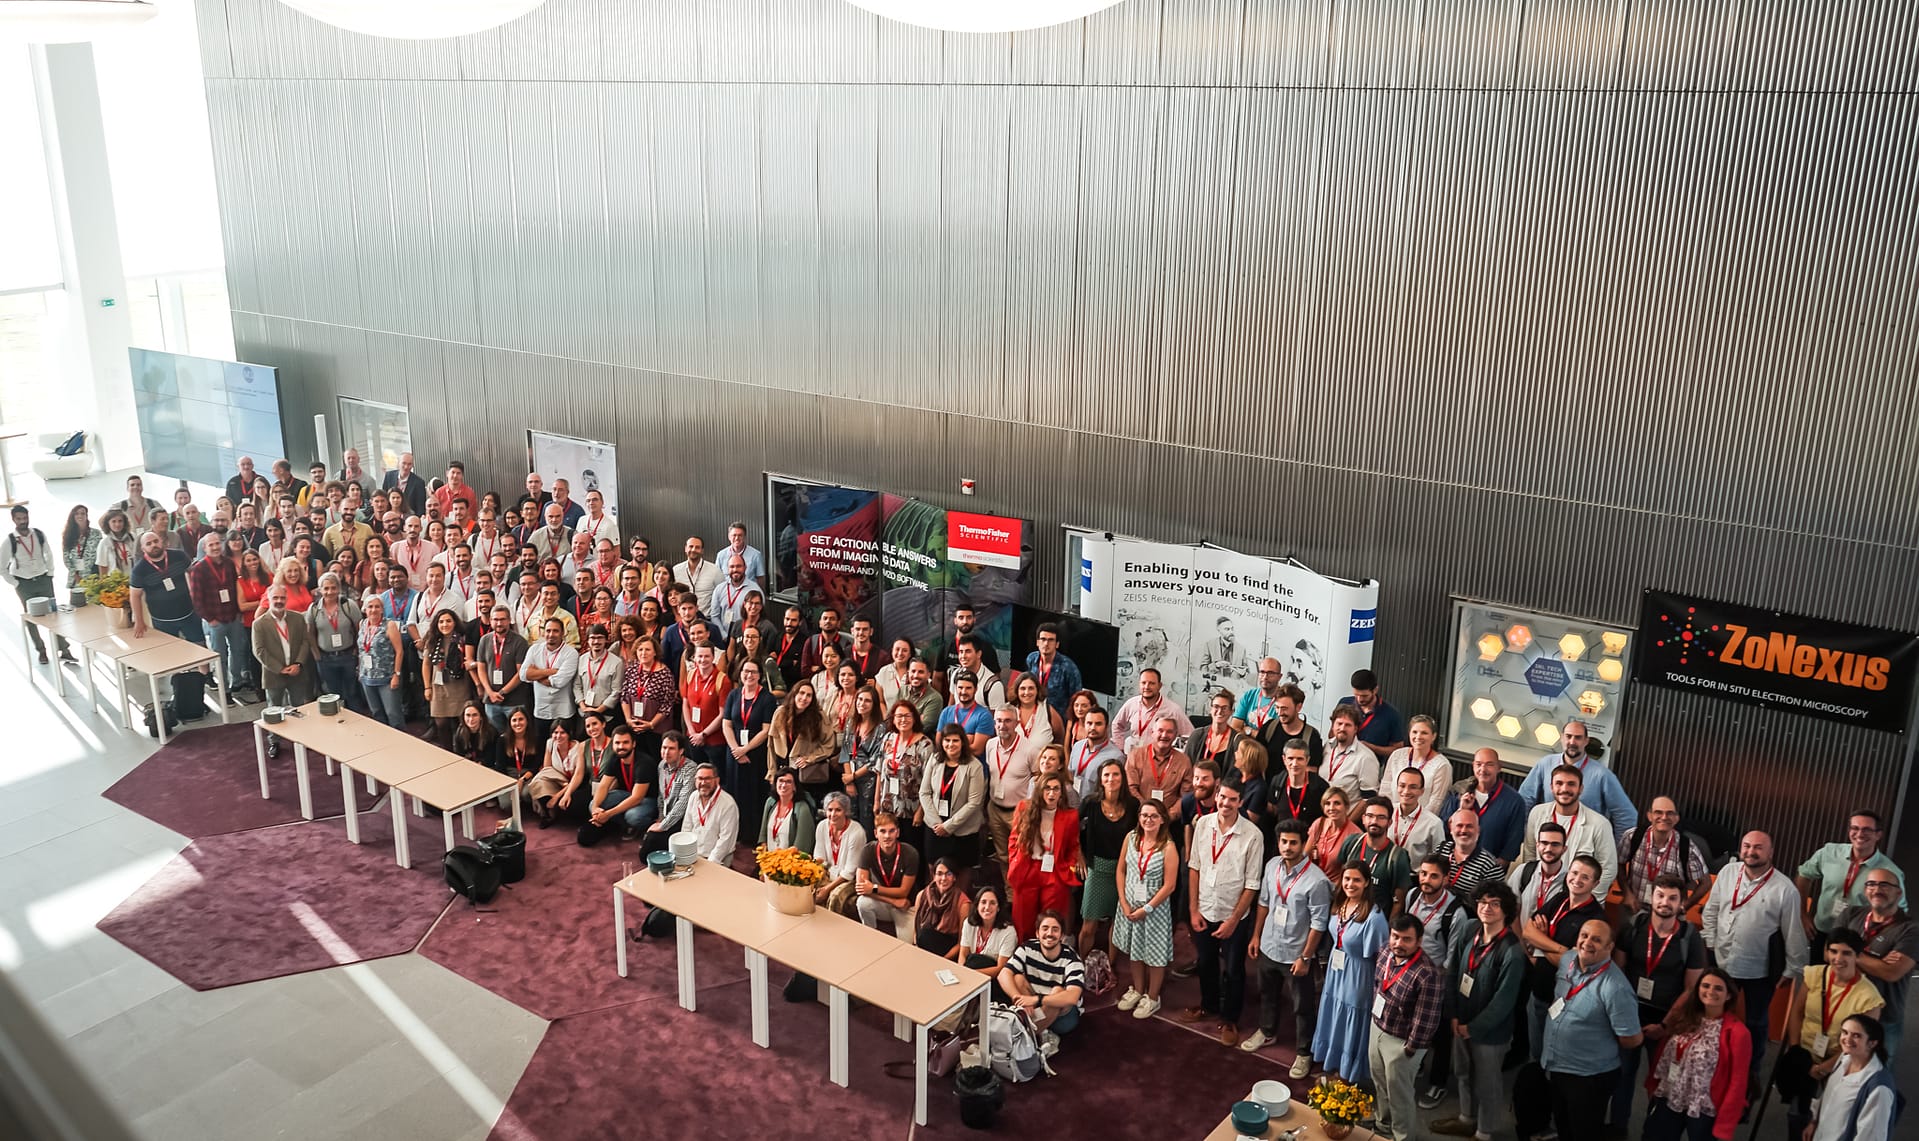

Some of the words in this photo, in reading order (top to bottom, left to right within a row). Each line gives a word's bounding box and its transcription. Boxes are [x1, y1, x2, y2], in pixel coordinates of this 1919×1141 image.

[959, 524, 1010, 538] ThermoFisher
[960, 533, 1009, 543] SCIENTIFIC
[810, 534, 831, 545] GET
[833, 537, 896, 555] ACTIONABLE
[898, 547, 936, 568] ANSWERS
[810, 547, 840, 559] FROM
[890, 557, 910, 572] DATA
[809, 561, 830, 570] WITH
[831, 563, 855, 573] AMIRA
[857, 566, 874, 576] AND
[897, 573, 928, 592] SOFTWARE
[1124, 562, 1189, 579] Enabling
[1194, 569, 1220, 580] you
[1225, 572, 1238, 583] to
[1243, 575, 1269, 590] find
[1273, 583, 1294, 597] the
[1123, 593, 1148, 602] ZEISS
[1151, 594, 1192, 606] Research
[1195, 599, 1243, 617] Microscopy
[1246, 608, 1284, 625] Solutions
[1124, 579, 1183, 591] answers
[1188, 584, 1213, 595] you
[1217, 588, 1238, 599] are
[1241, 592, 1301, 619] searching
[1304, 608, 1321, 625] for.
[1351, 617, 1376, 629] ZEIS
[1719, 623, 1891, 691] ZoNexus
[1666, 672, 1696, 685] TOOLS
[1697, 678, 1716, 689] FOR
[1717, 682, 1728, 691] IN
[1729, 684, 1751, 696] SITU
[1751, 689, 1801, 707] ELECTRON
[1802, 699, 1869, 719] MICROSCOPY
